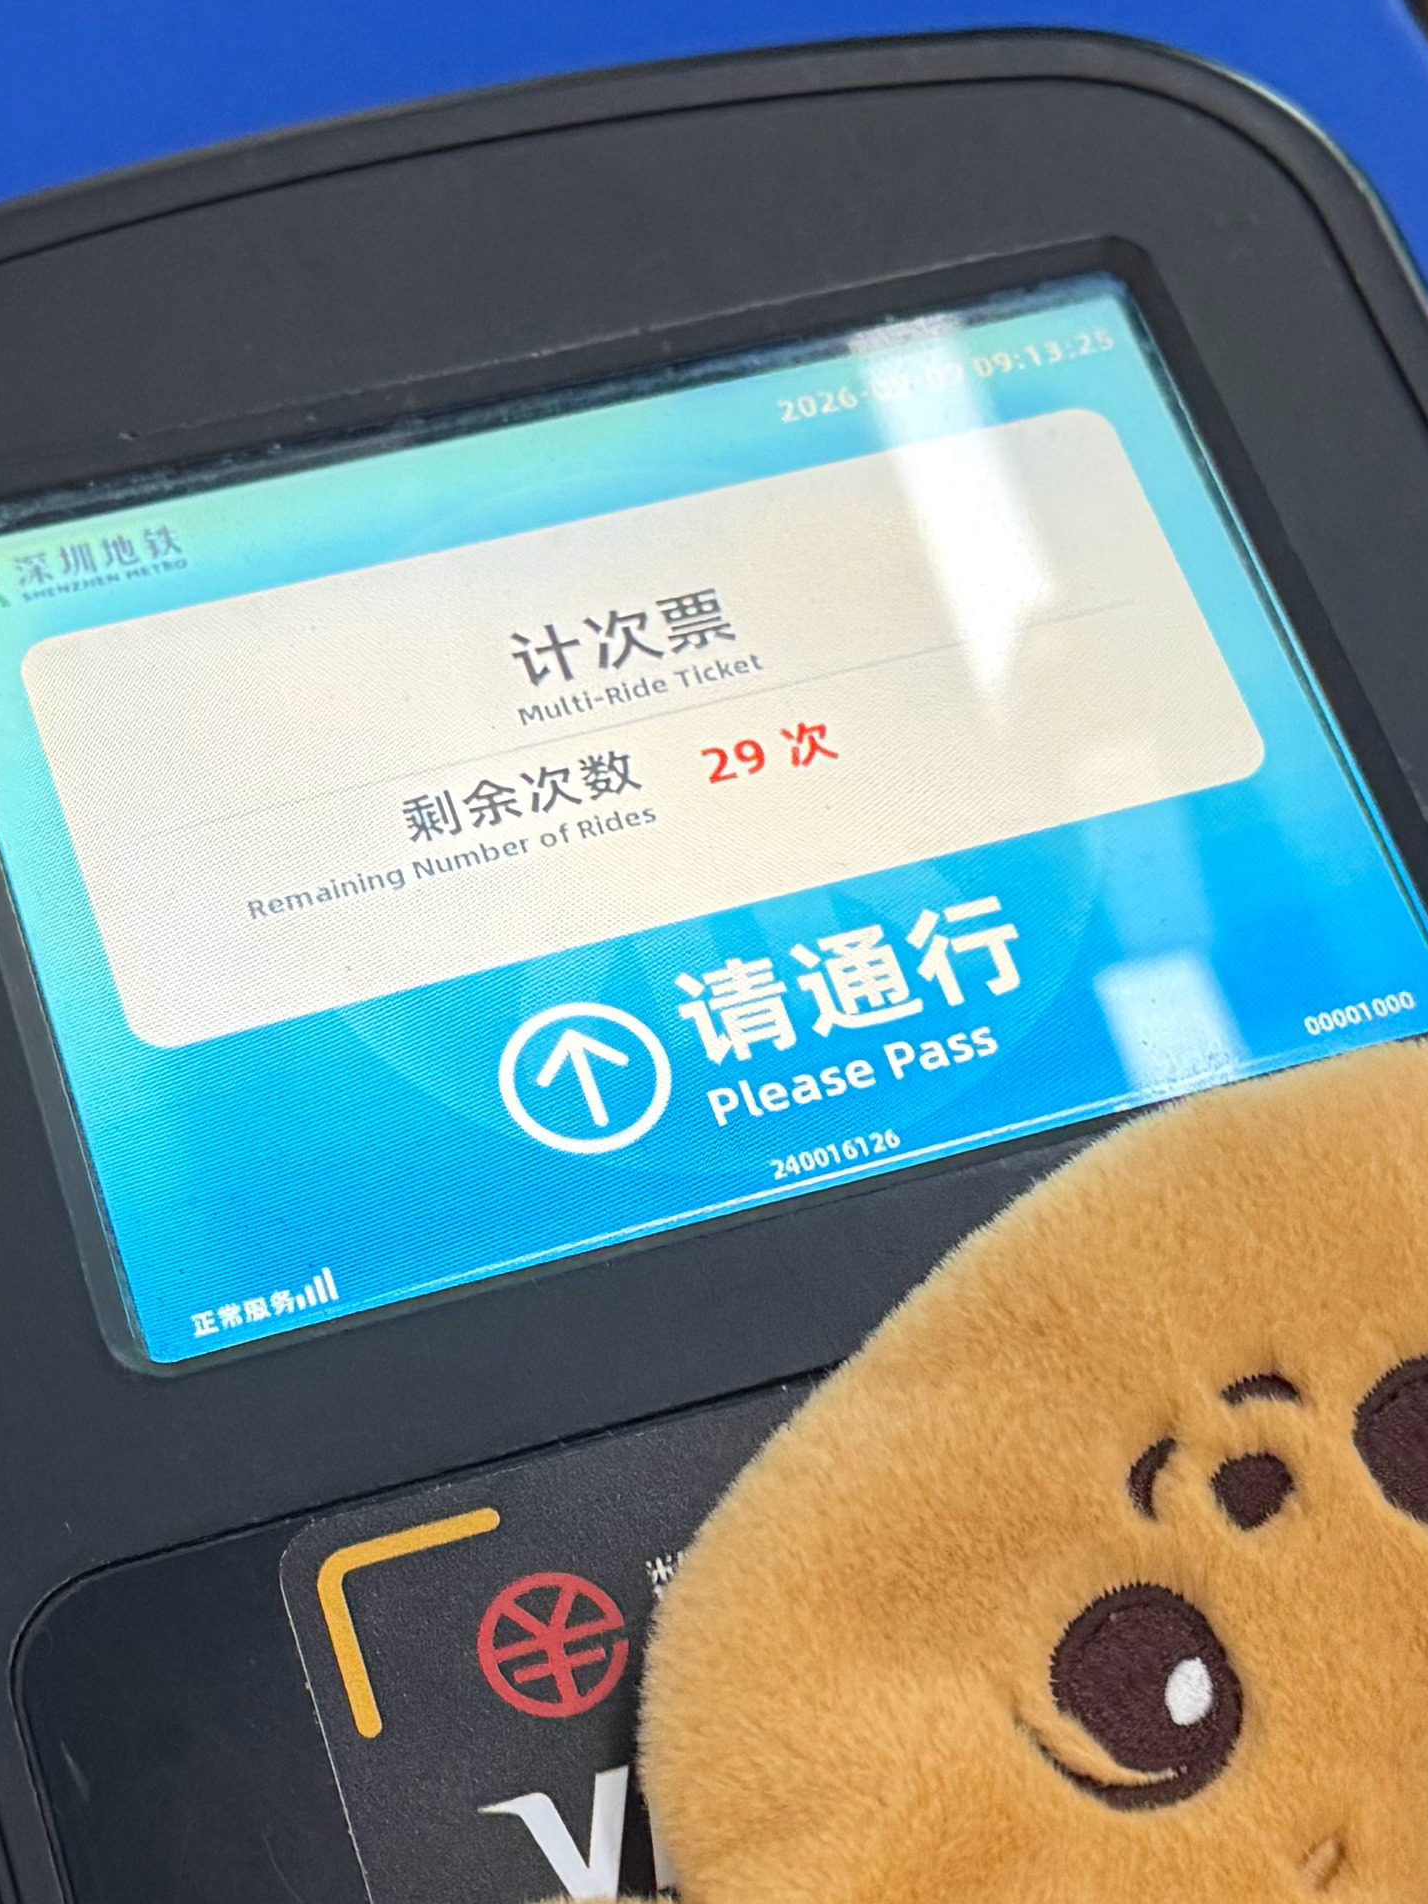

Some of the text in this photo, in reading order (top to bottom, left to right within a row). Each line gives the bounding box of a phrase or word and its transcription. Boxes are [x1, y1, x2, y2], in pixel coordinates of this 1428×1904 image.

[973, 329, 1115, 379] 09:13:25
[13, 524, 182, 586] 深圳地铁
[22, 557, 188, 603] SHENZHEN METRO
[509, 587, 737, 688] 计次票
[517, 652, 764, 727] Multi-Ride Ticket
[401, 721, 840, 845] 剩余次数 29 次
[246, 804, 658, 920] Remaining Number of Rides
[673, 894, 1022, 1066] 请通行
[1303, 990, 1417, 1037] 00001000
[705, 1025, 1000, 1128] Please Pass
[769, 1127, 901, 1181] 240016126
[189, 1289, 296, 1339] 正常服务
